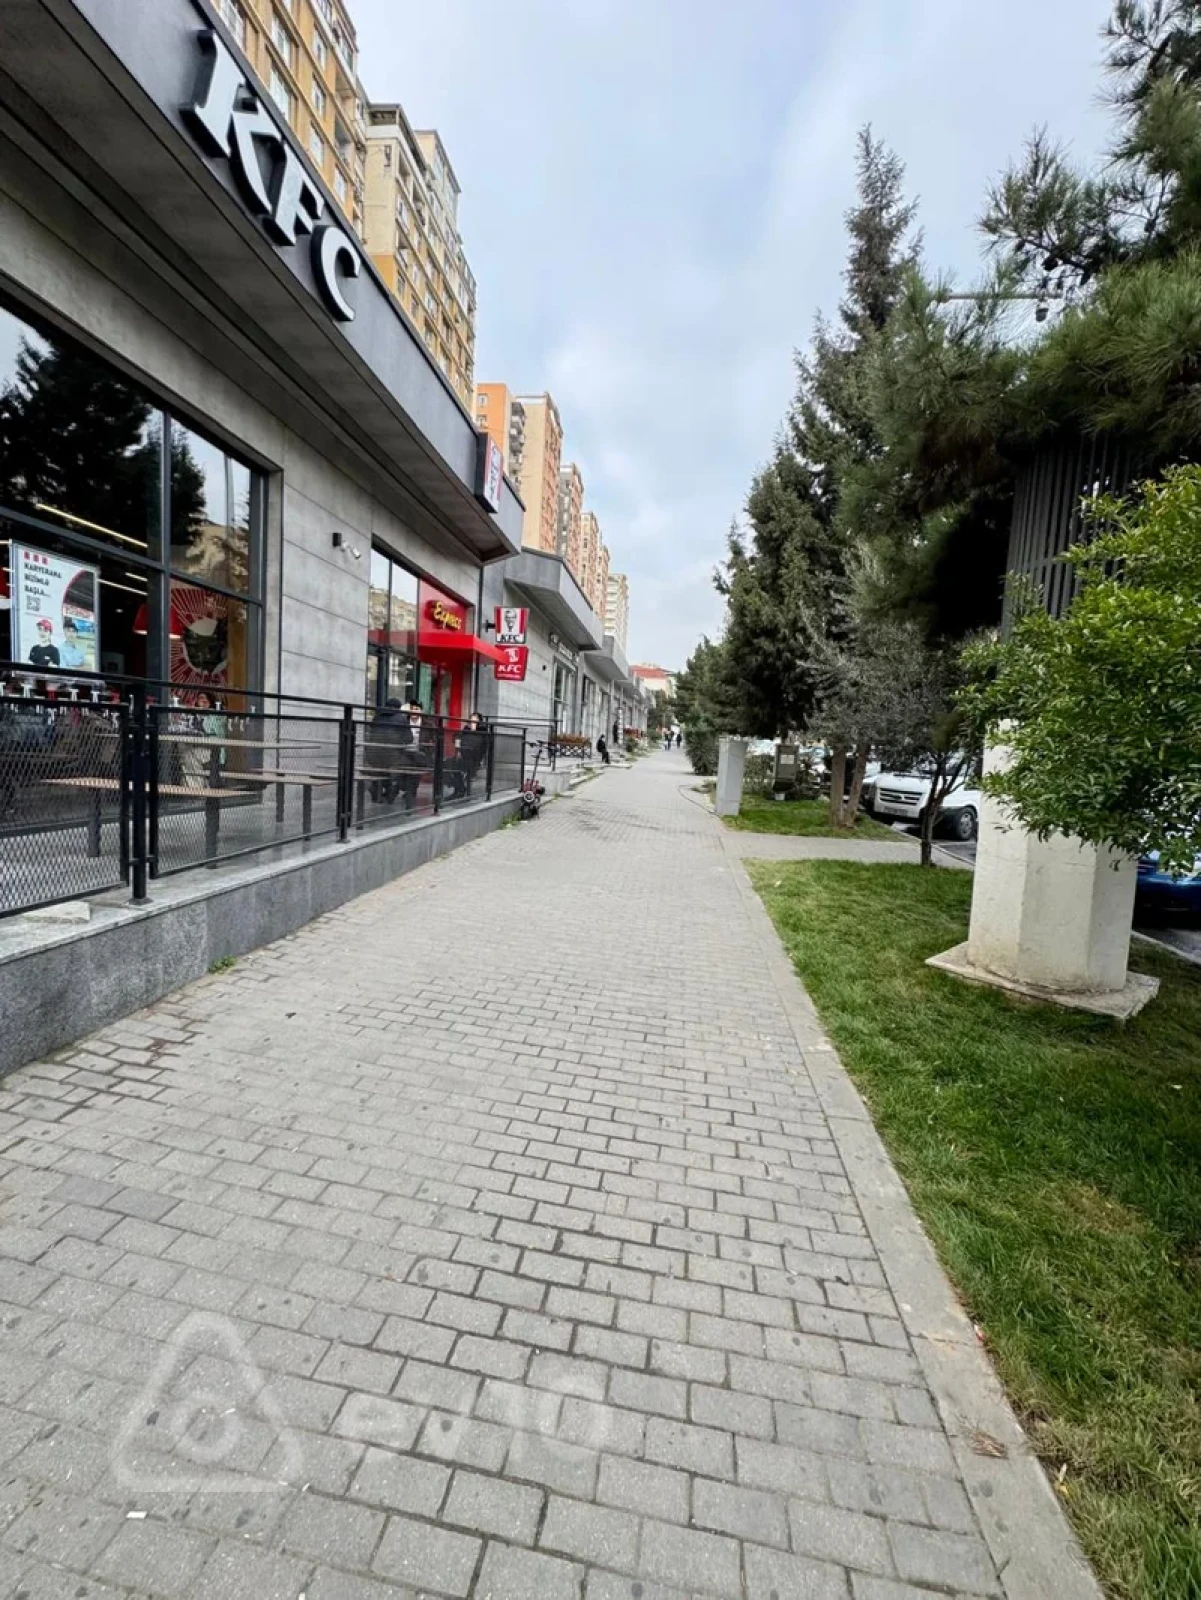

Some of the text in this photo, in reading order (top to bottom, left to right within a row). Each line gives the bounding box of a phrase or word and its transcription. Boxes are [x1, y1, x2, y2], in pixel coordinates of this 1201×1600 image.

[181, 29, 361, 322] KFC
[500, 633, 523, 643] KFC
[498, 664, 522, 673] KFC
